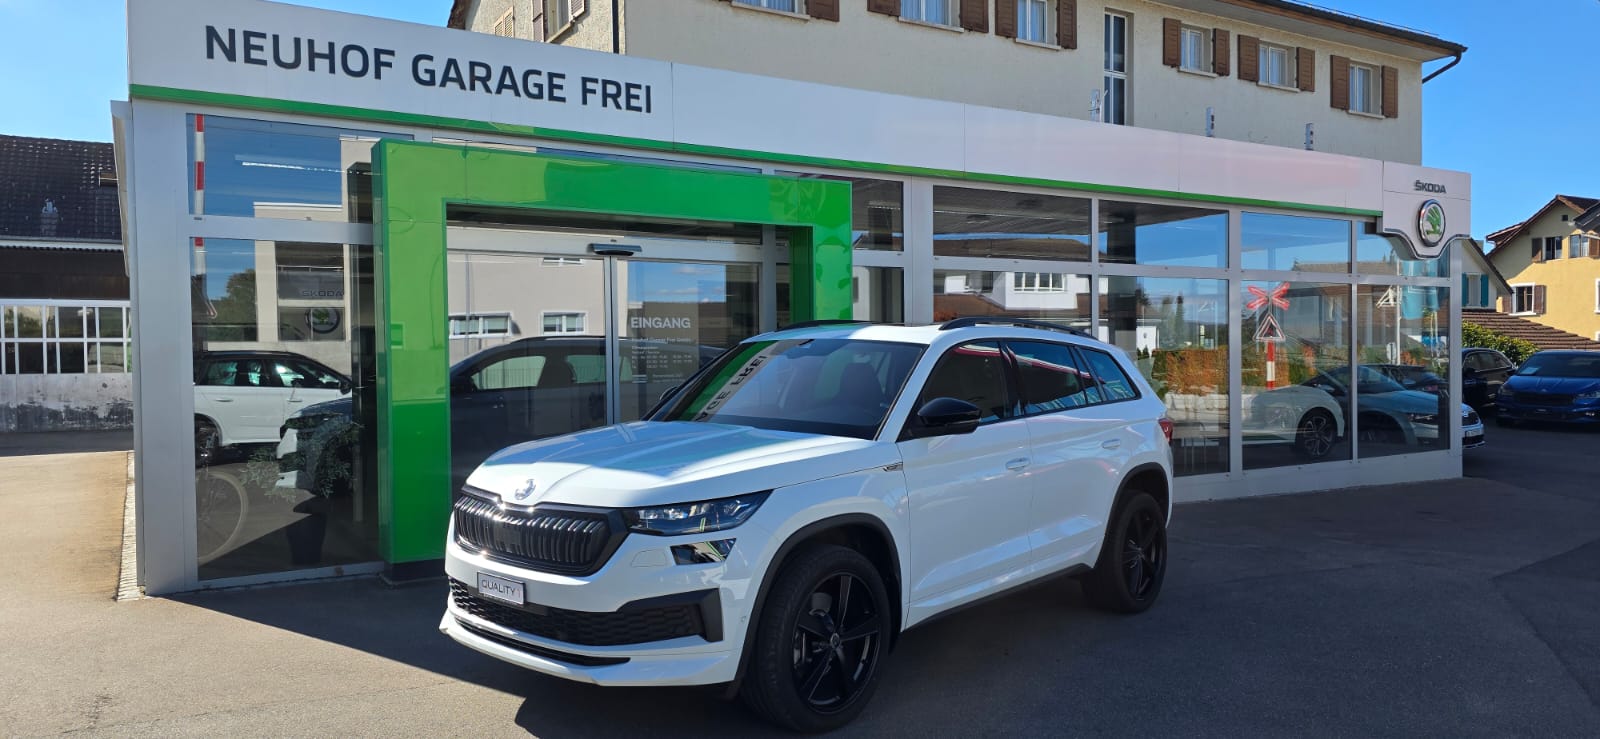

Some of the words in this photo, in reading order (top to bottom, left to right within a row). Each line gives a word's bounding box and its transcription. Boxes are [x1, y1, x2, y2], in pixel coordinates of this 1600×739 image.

[205, 25, 395, 80] NEUHOF
[411, 54, 566, 103] GARAGE
[581, 76, 652, 113] FREI
[1414, 180, 1446, 193] ŠKODA
[630, 317, 691, 329] EINGANG
[482, 579, 515, 595] QUALITY
